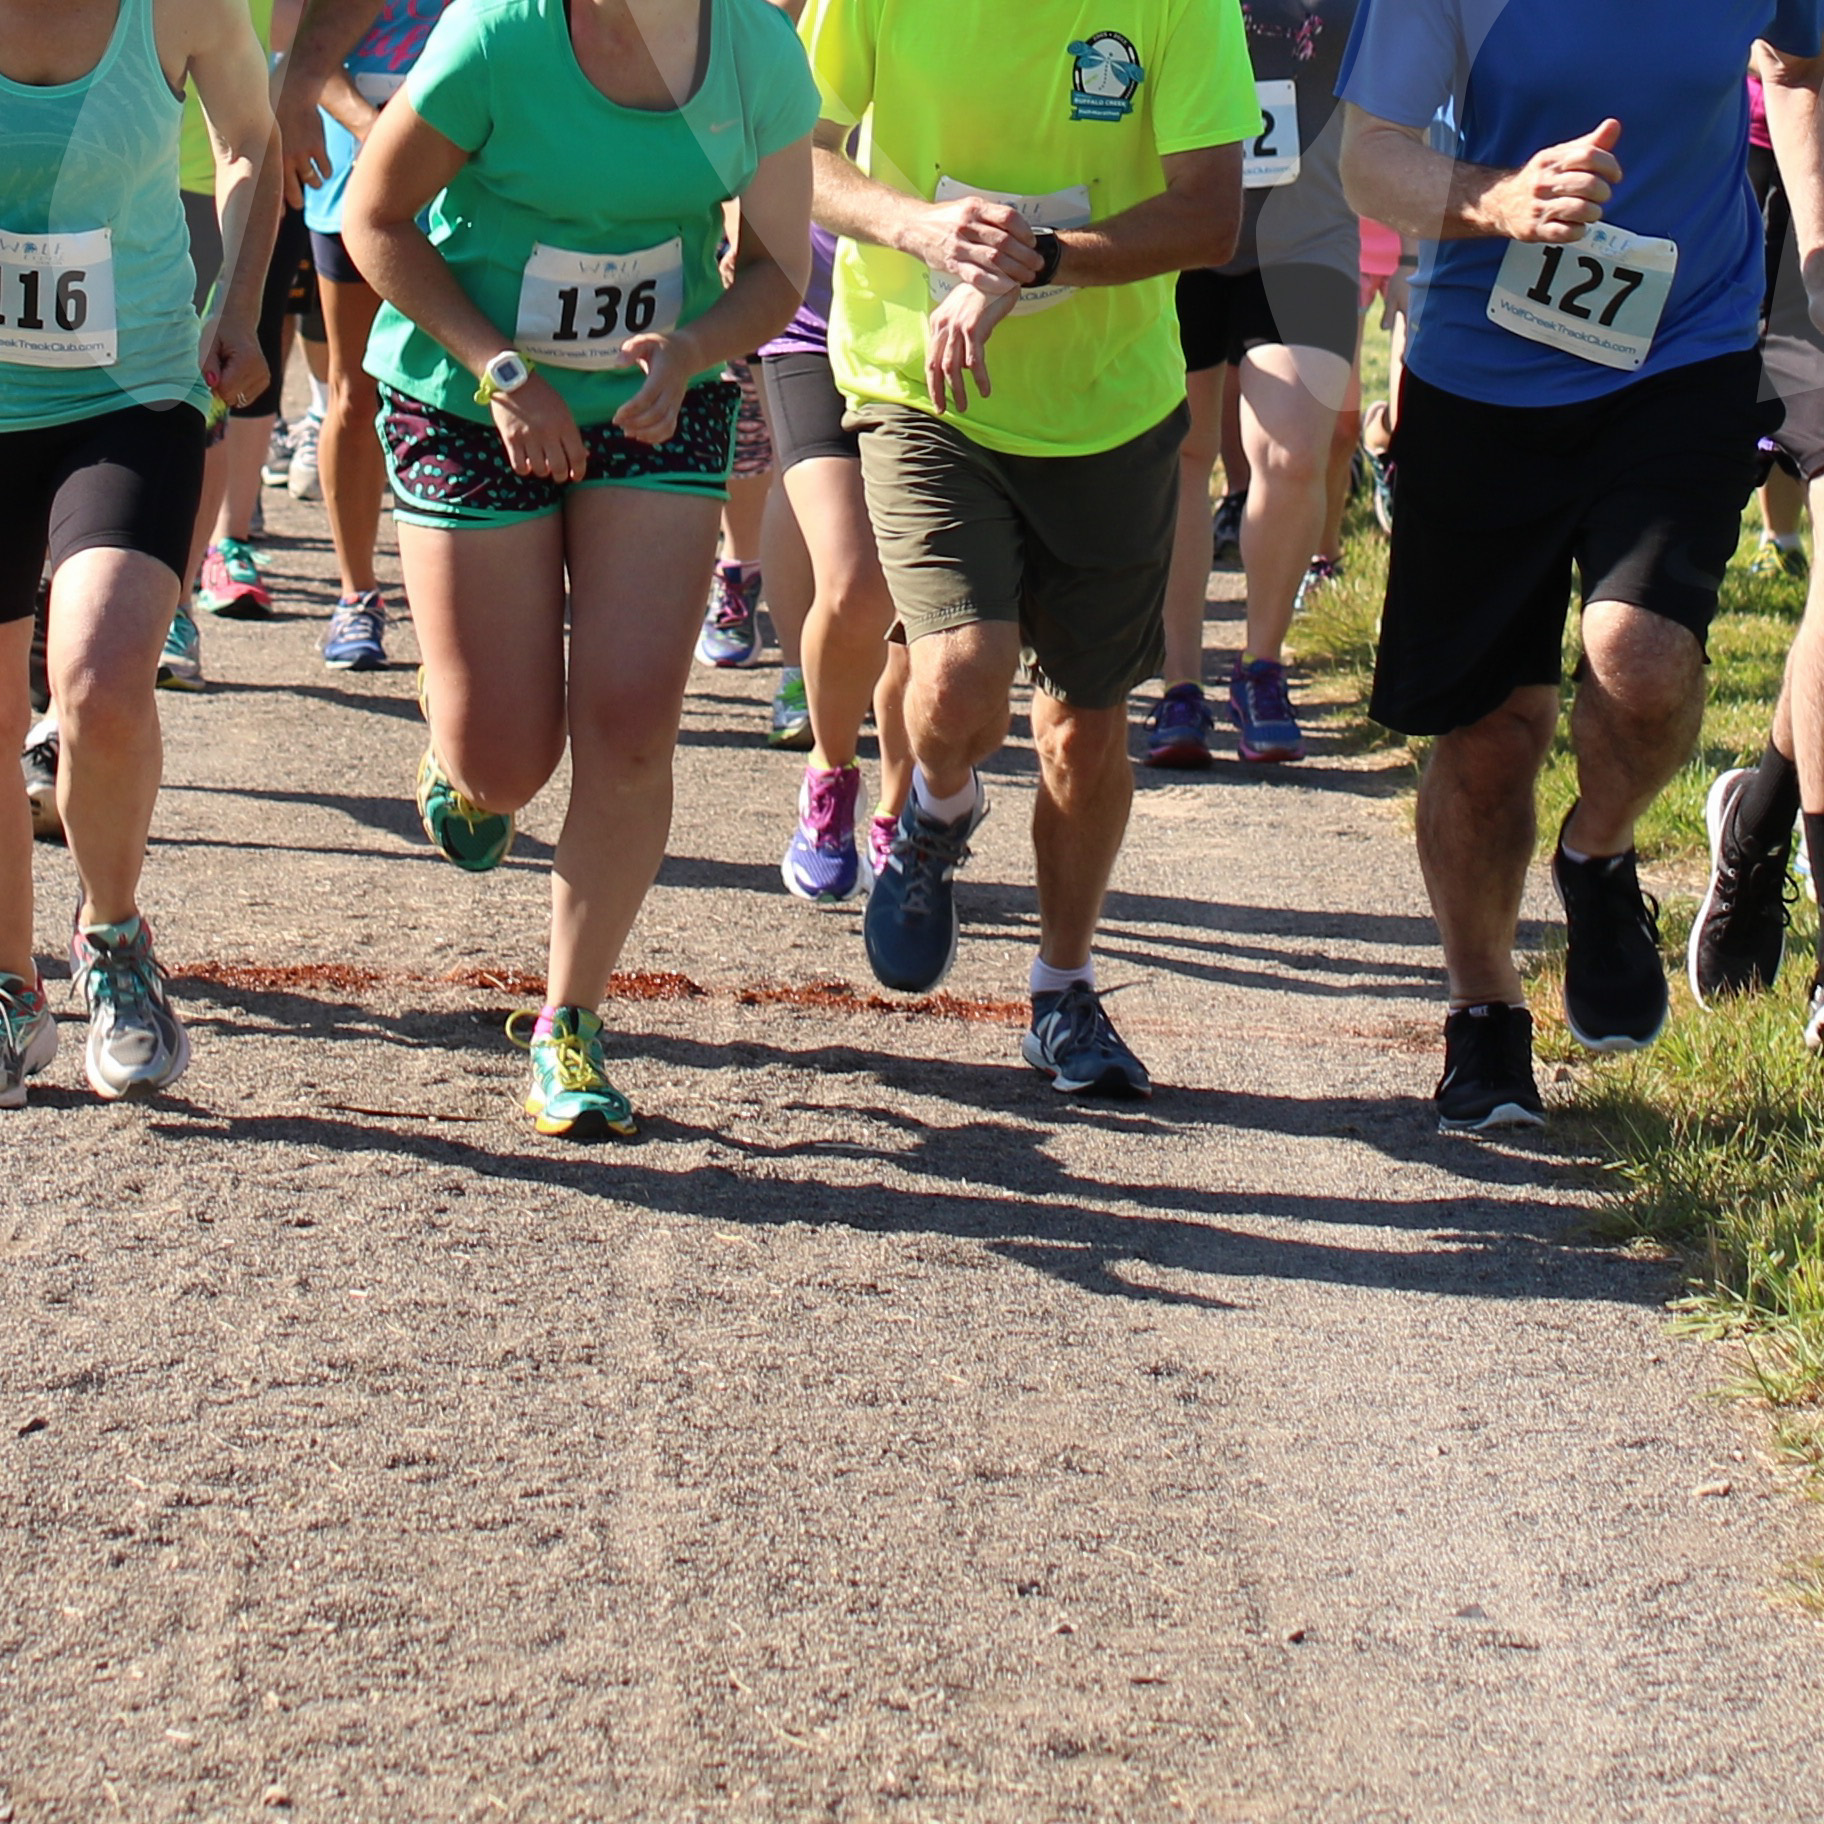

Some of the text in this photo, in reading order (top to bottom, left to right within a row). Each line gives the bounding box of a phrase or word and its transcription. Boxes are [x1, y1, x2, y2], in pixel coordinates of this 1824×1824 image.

[552, 279, 657, 341] 136
[1527, 245, 1644, 327] 127
[1500, 298, 1637, 355] WolfCreekTrackClub.com
